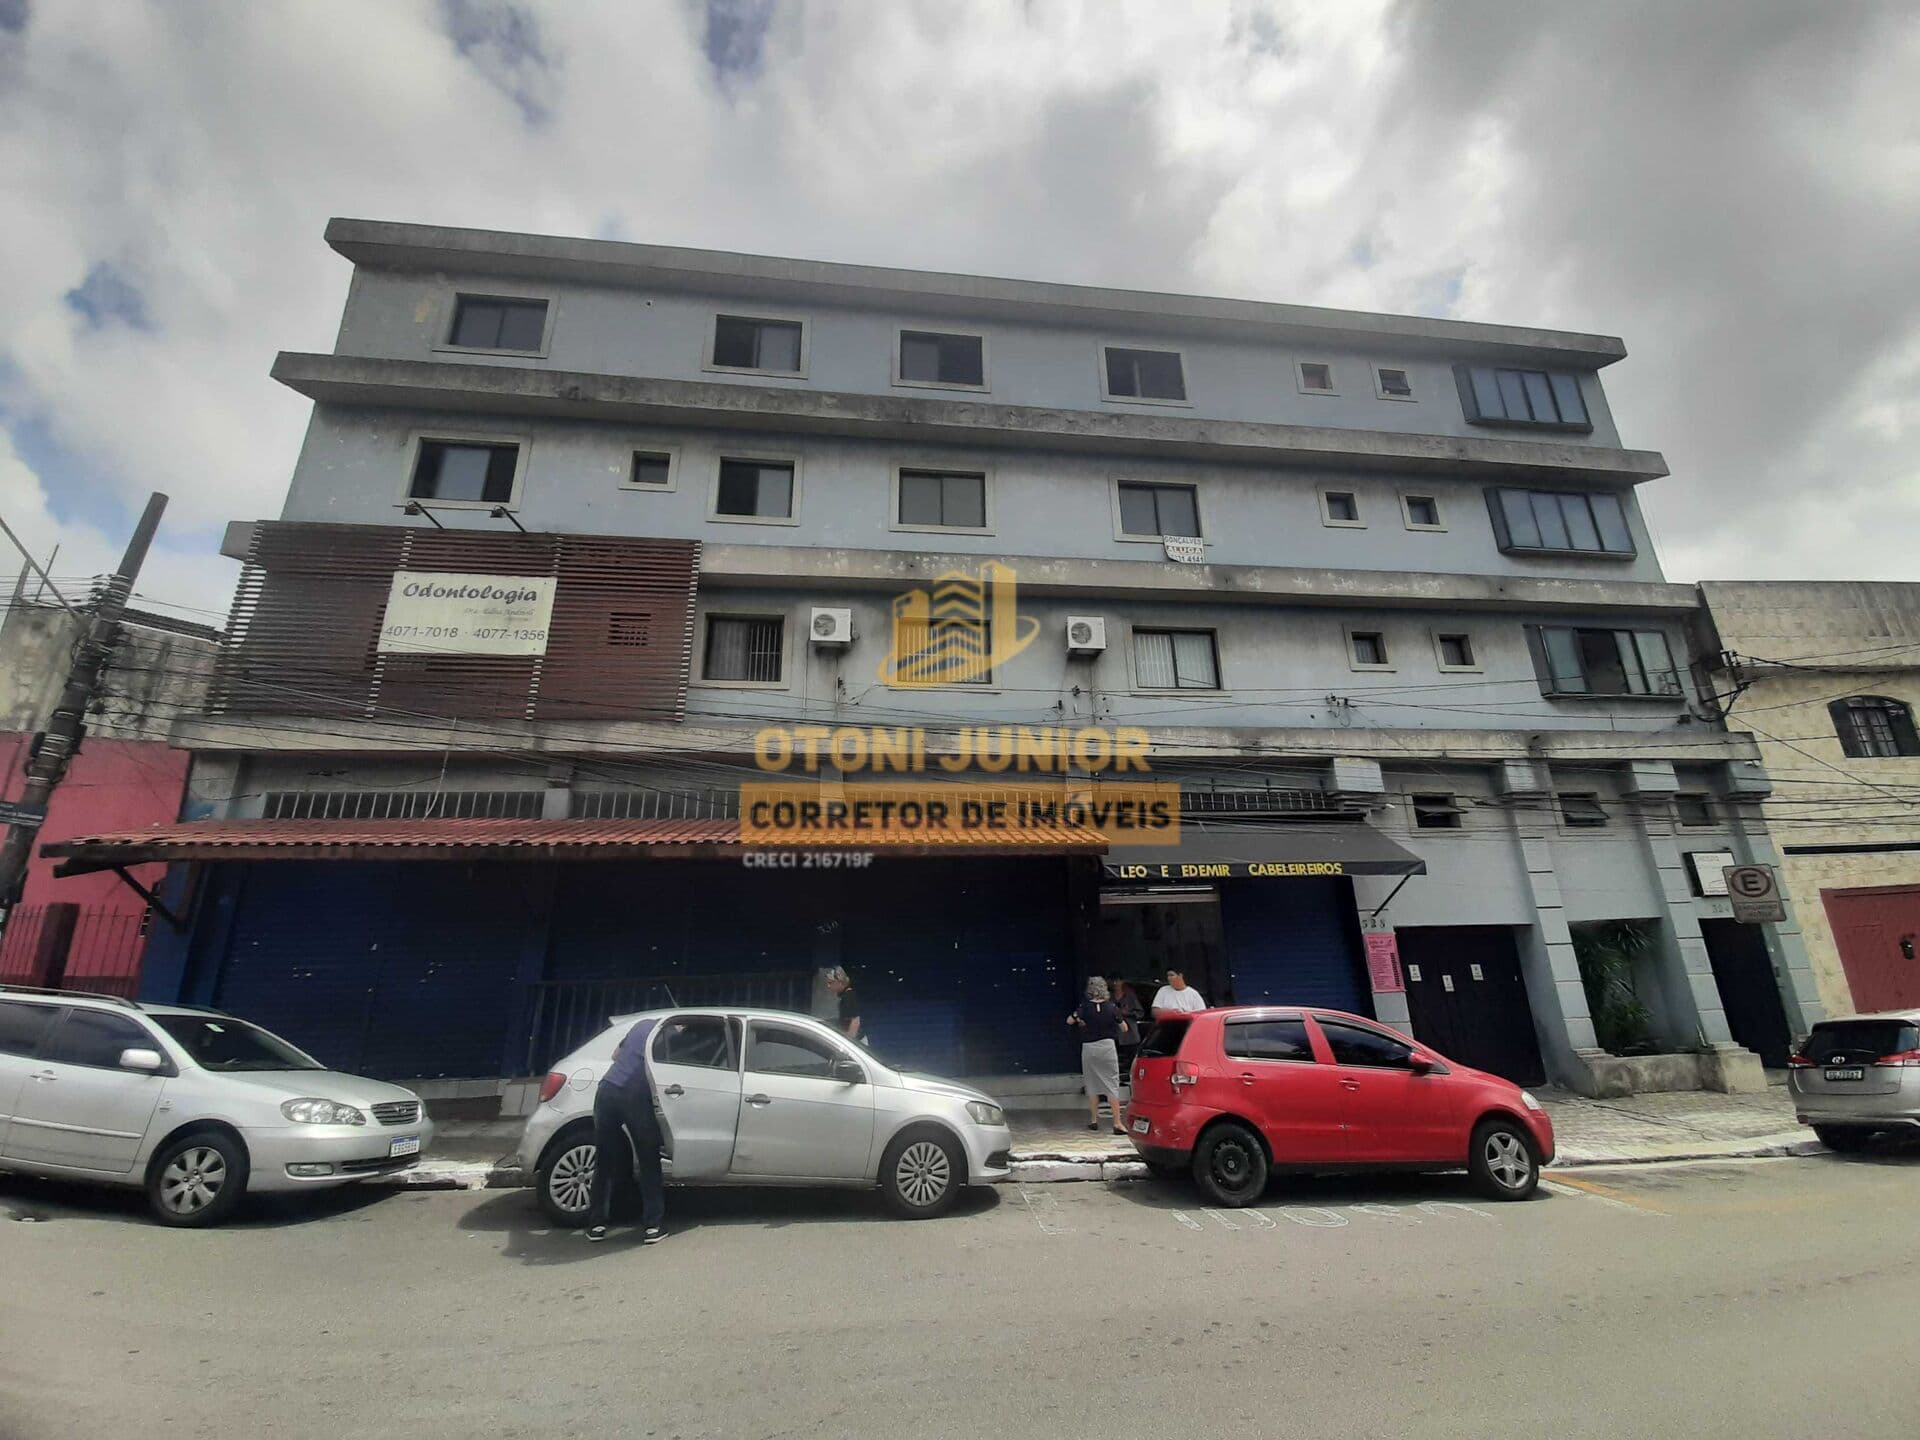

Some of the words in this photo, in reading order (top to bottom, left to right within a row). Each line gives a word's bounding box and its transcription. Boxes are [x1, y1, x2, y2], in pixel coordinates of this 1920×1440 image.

[403, 582, 538, 604] Odontologia
[385, 626, 458, 638] 4071-7018
[473, 628, 545, 640] 4077-1356
[1120, 865, 1148, 879] LEO
[1161, 865, 1169, 878] E
[1182, 864, 1231, 878] EDEMIR
[1249, 862, 1343, 876] CABELEIREIROS
[1740, 872, 1762, 891] E
